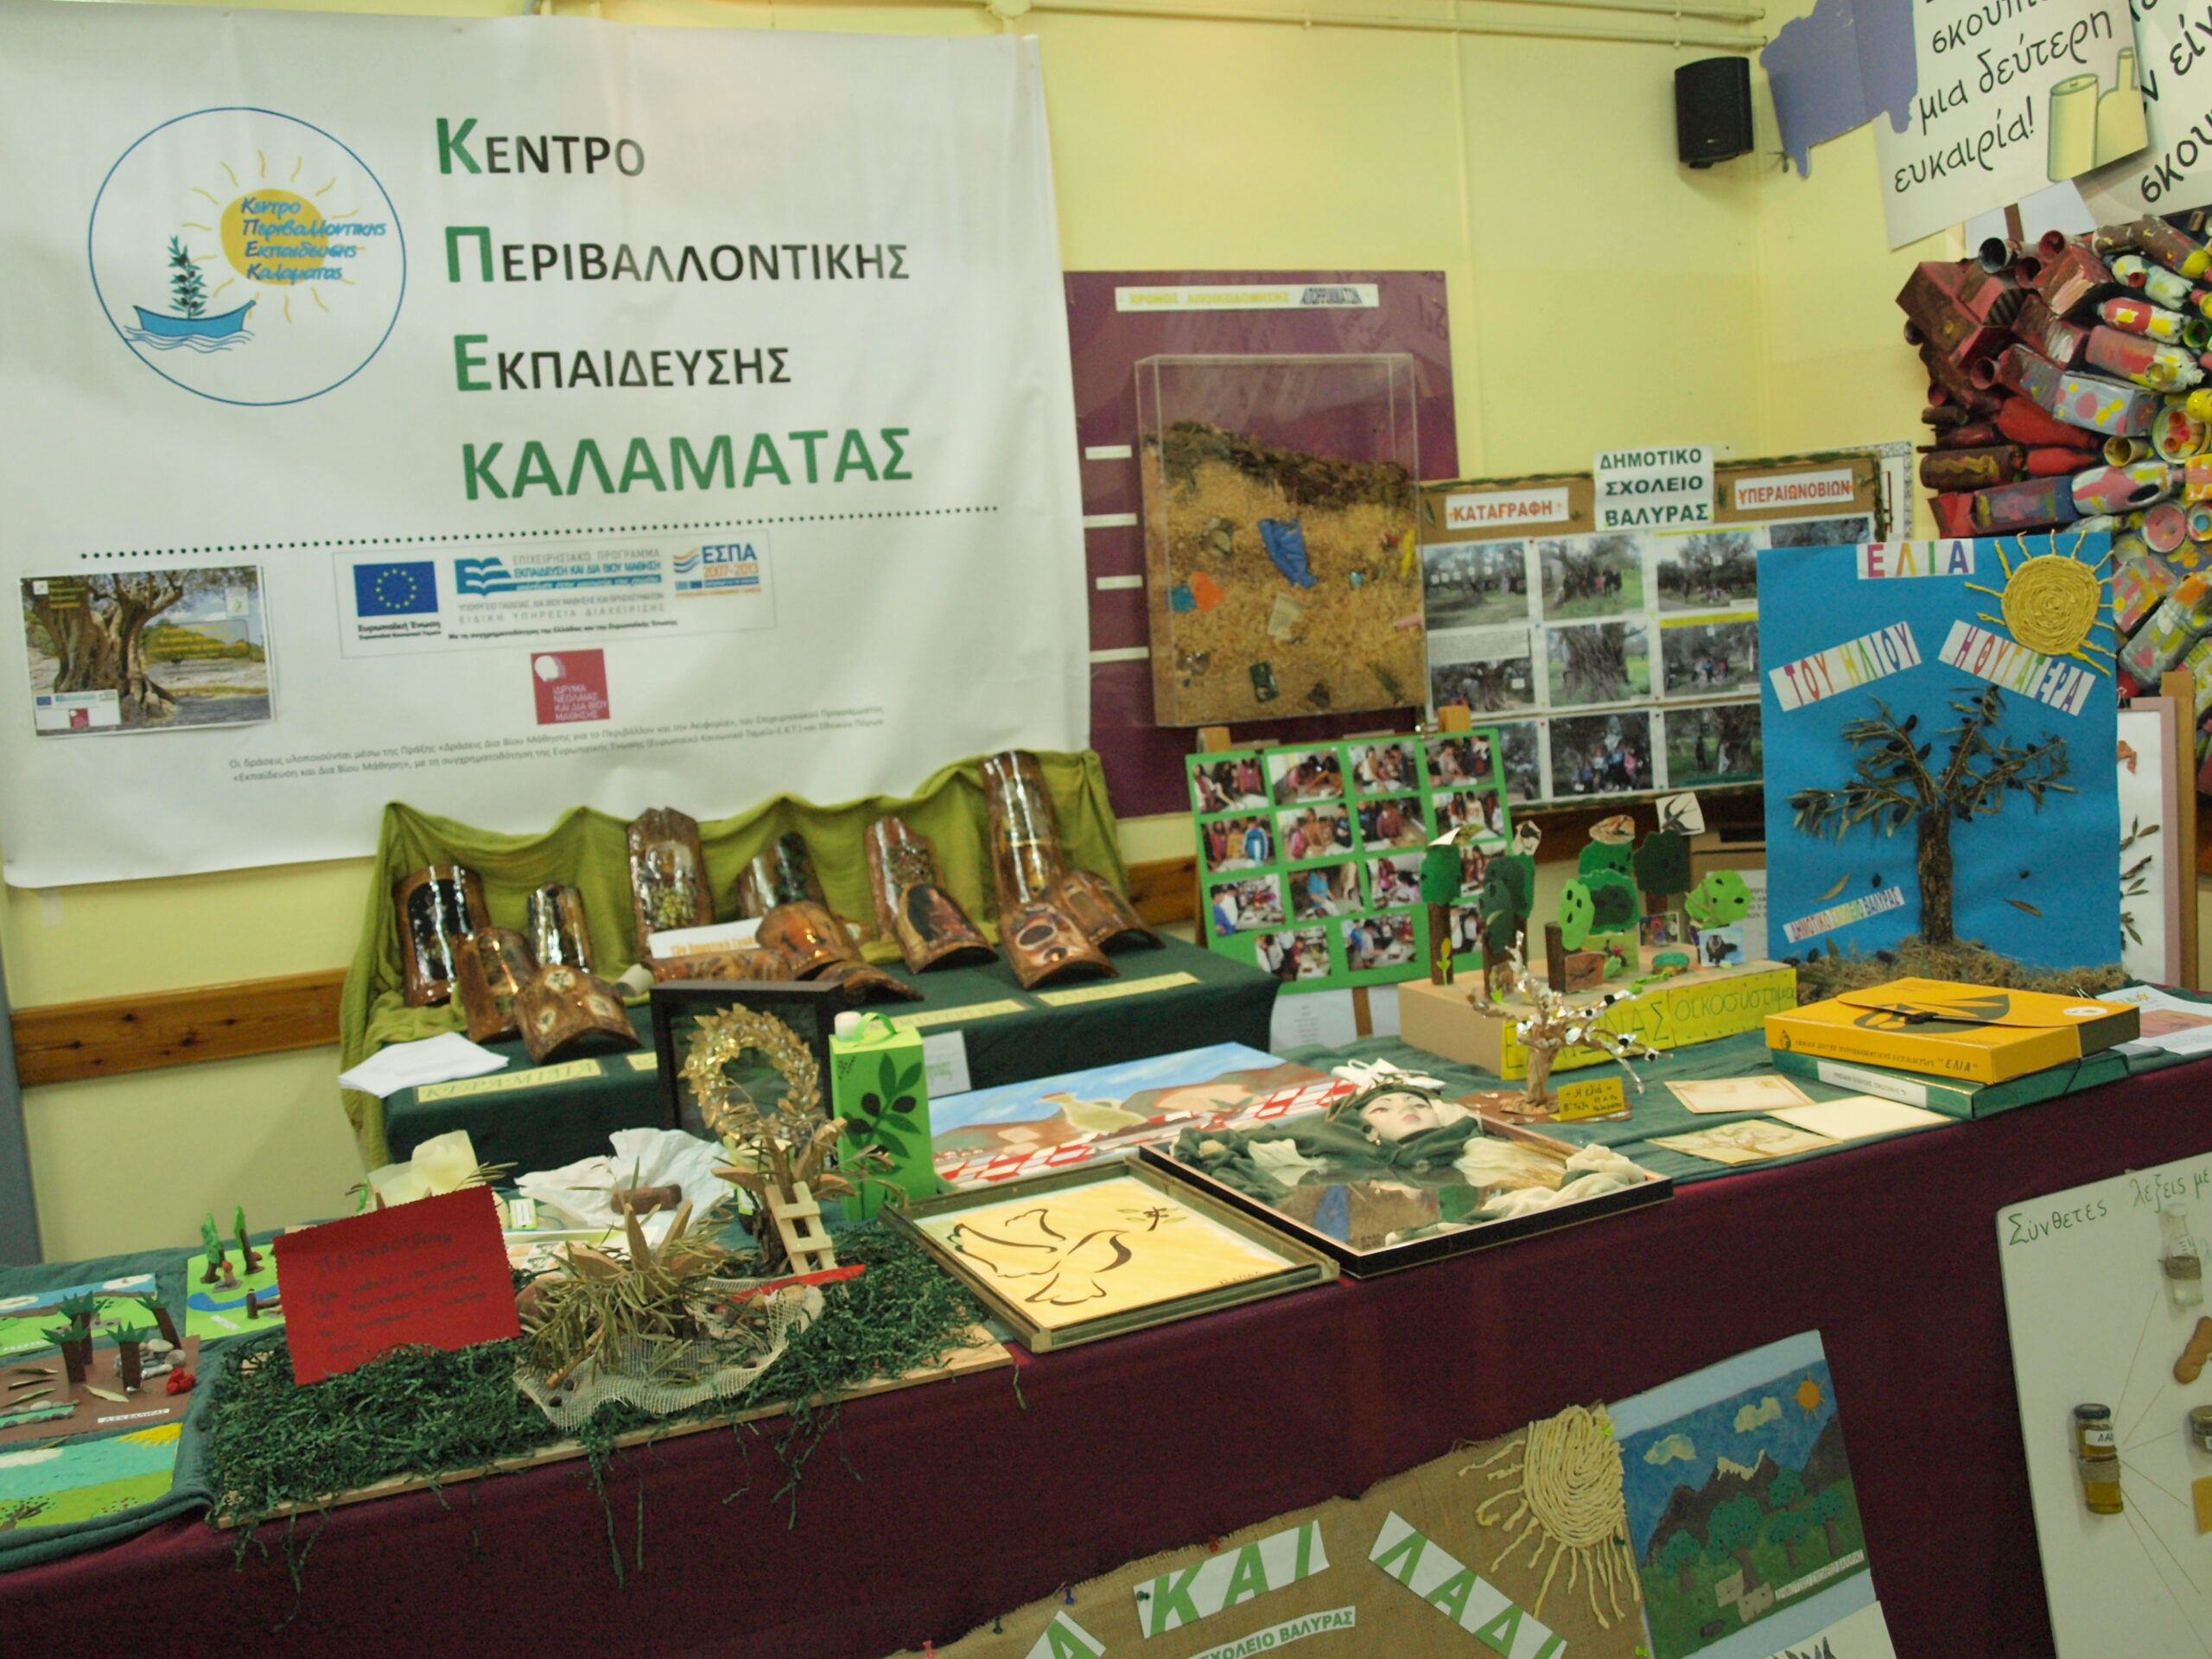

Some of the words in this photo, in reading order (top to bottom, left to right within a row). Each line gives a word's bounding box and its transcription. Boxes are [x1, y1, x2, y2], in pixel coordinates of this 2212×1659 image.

[1919, 79, 1968, 136] μια
[1978, 10, 2113, 93] δεύτερη
[1895, 96, 2034, 193] ευκαιρία!
[444, 226, 910, 283] ΠΕΡΙΒΑΛΛΟΝΤΙΚΗΣ
[454, 334, 791, 391] ΕΚΠΑΙΔΕΥΣΗΣ
[462, 428, 912, 500] ΚΑΛΑΜΑΤΑΣ
[1599, 448, 1702, 470] ΔΗΜΟΤΙΚΟ
[1605, 475, 1703, 497] ΣΧΟΛΕΙΟ
[1737, 480, 1853, 505] ΥΠΕΡΑΙΩΝΟΒΙΩΝ
[1452, 500, 1554, 522] ΚΑΤΑΓΡΑΦΗ
[1605, 503, 1708, 527] ΒΑΛΥΡΑΣ
[702, 543, 758, 564] ΕΣΠΑ
[1866, 540, 1969, 578] ΕΛΙΑ
[1783, 651, 1834, 706] ΤΟΥ
[1838, 621, 1916, 687] ΗΛΙΟΥ
[2008, 1199, 2107, 1246] Σύνθετες
[2130, 1173, 2186, 1214] λέξεις
[2193, 1168, 2210, 1200] με
[1150, 1520, 1313, 1637] ΚΑΙ
[1376, 1529, 1566, 1659] ΛΑΔ
[1279, 1611, 1354, 1649] ΒΑΛΥΡΑΣ
